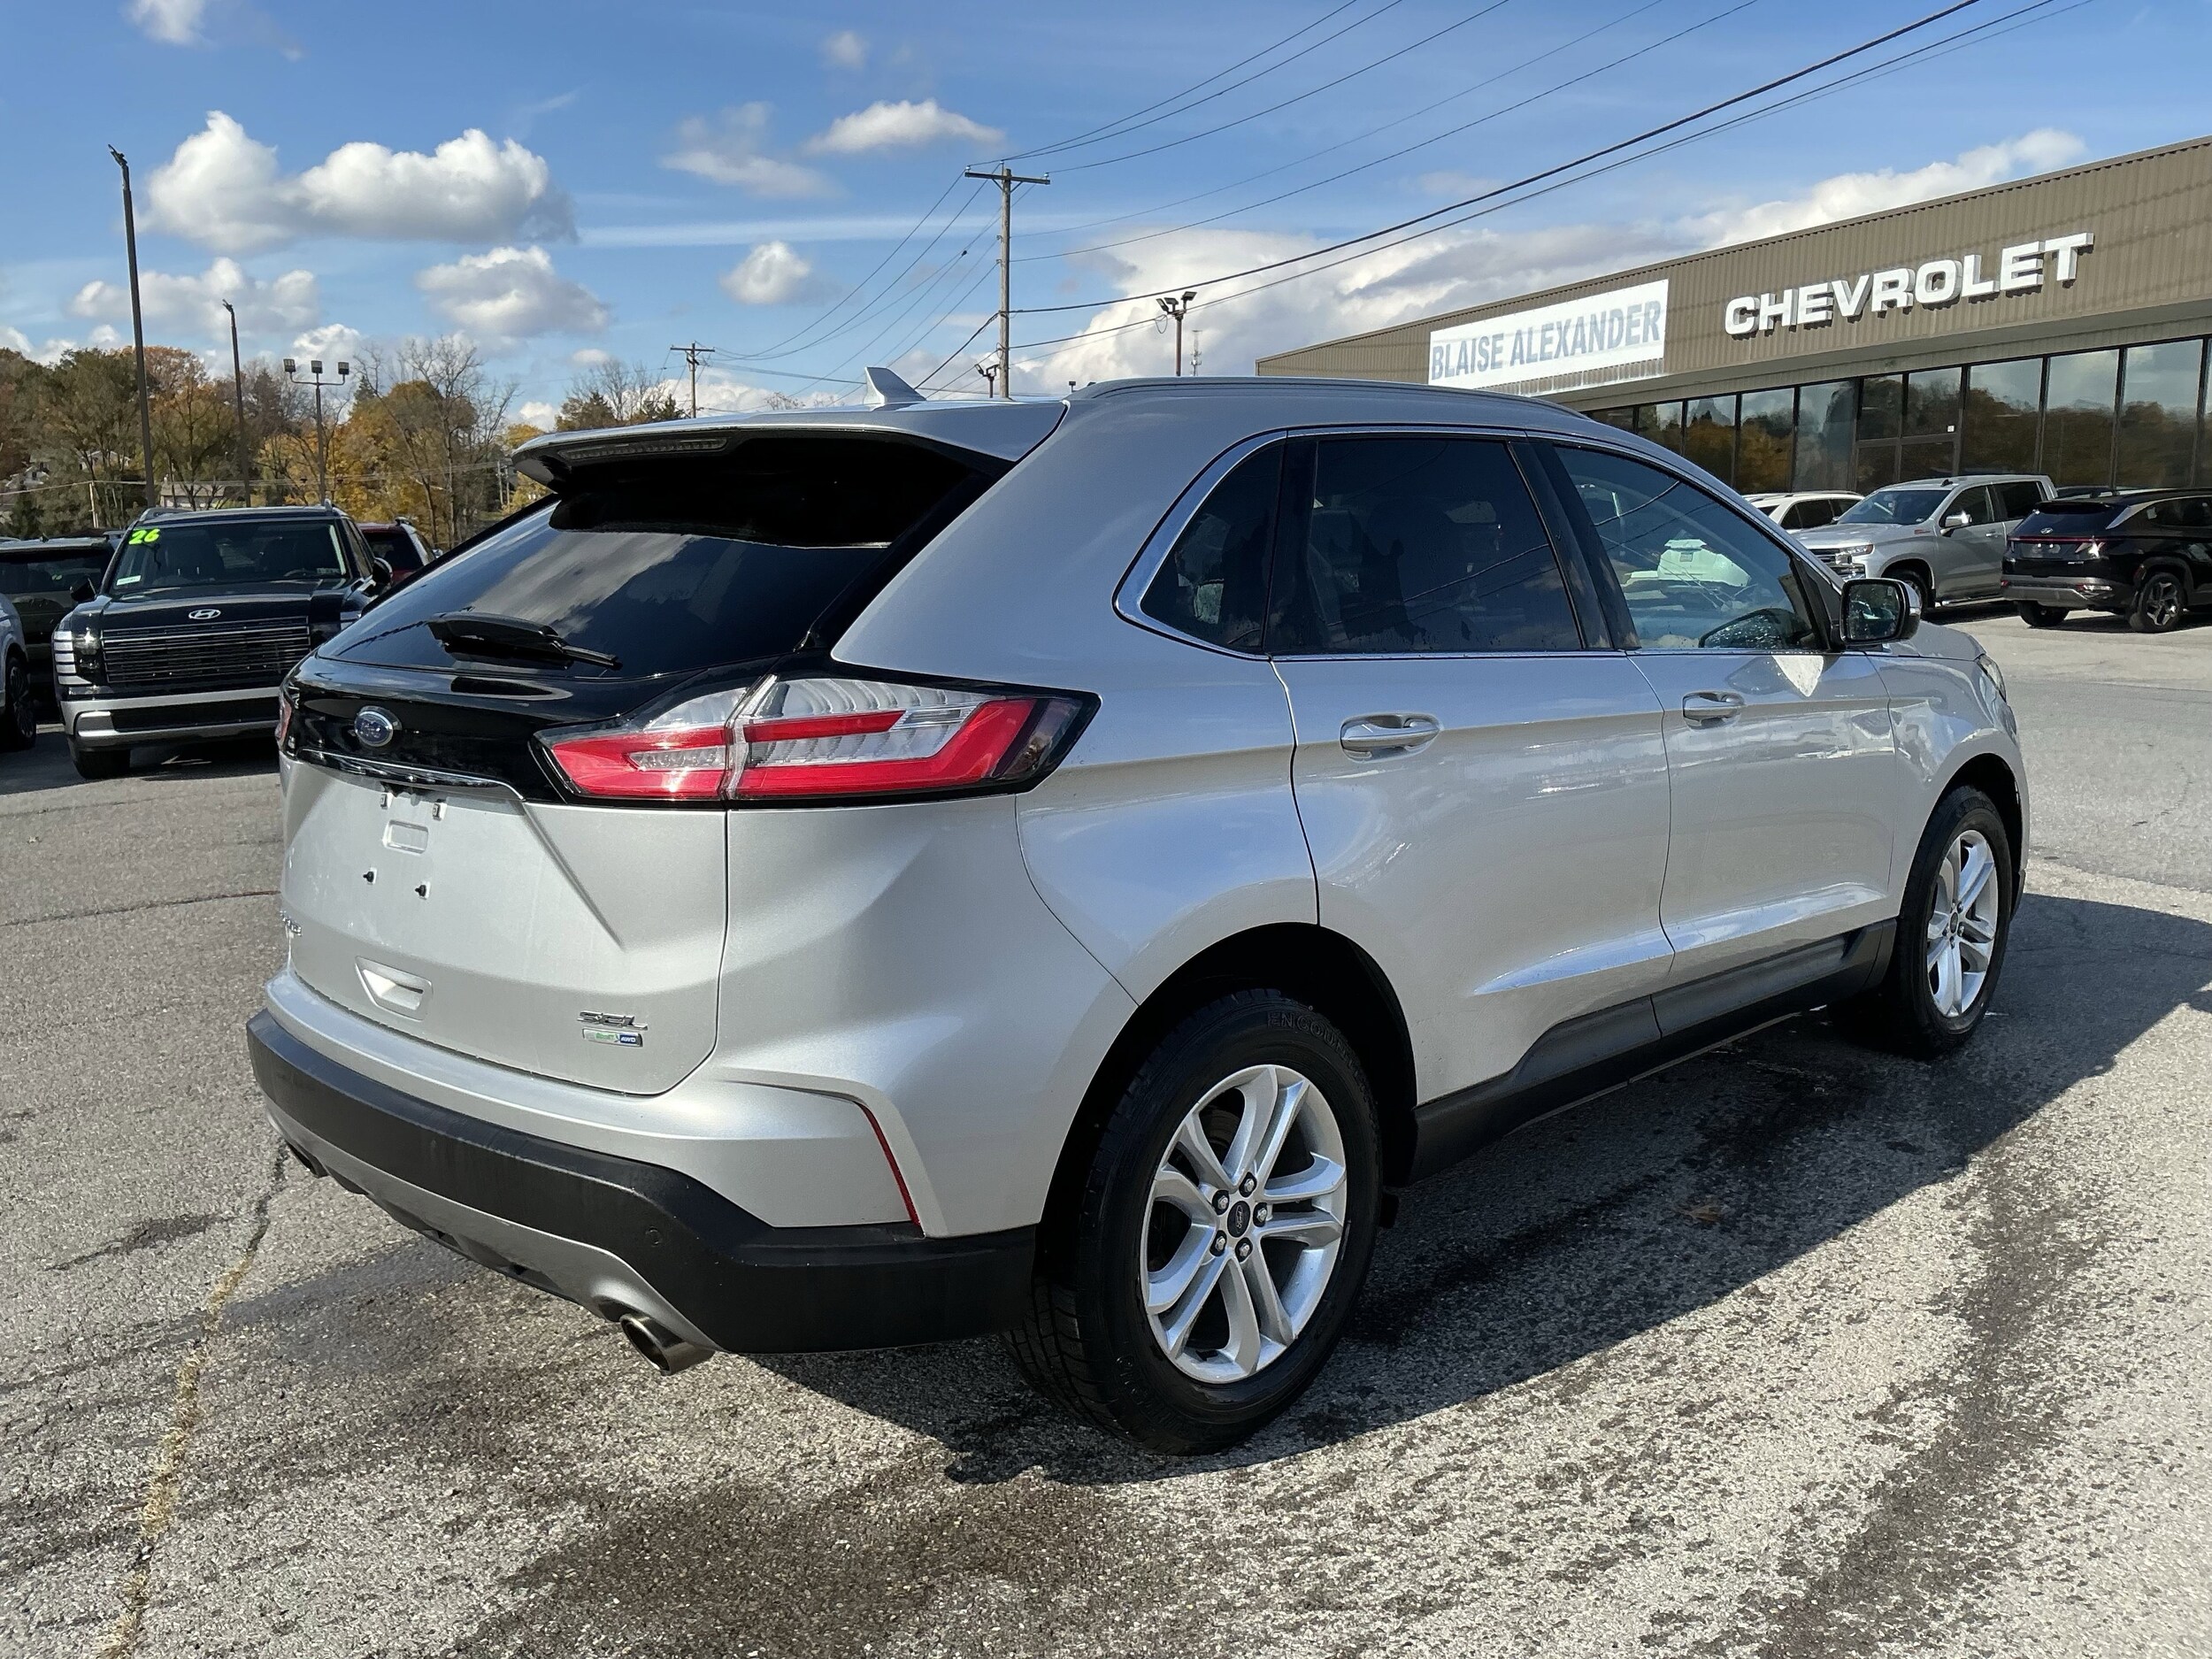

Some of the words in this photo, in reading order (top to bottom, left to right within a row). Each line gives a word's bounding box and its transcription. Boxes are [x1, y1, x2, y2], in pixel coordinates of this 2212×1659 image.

[1724, 233, 2093, 334] CHEVROLET
[1432, 333, 1504, 380] BLAISE
[1509, 300, 1662, 366] ALEXANDER
[128, 528, 160, 544] 26
